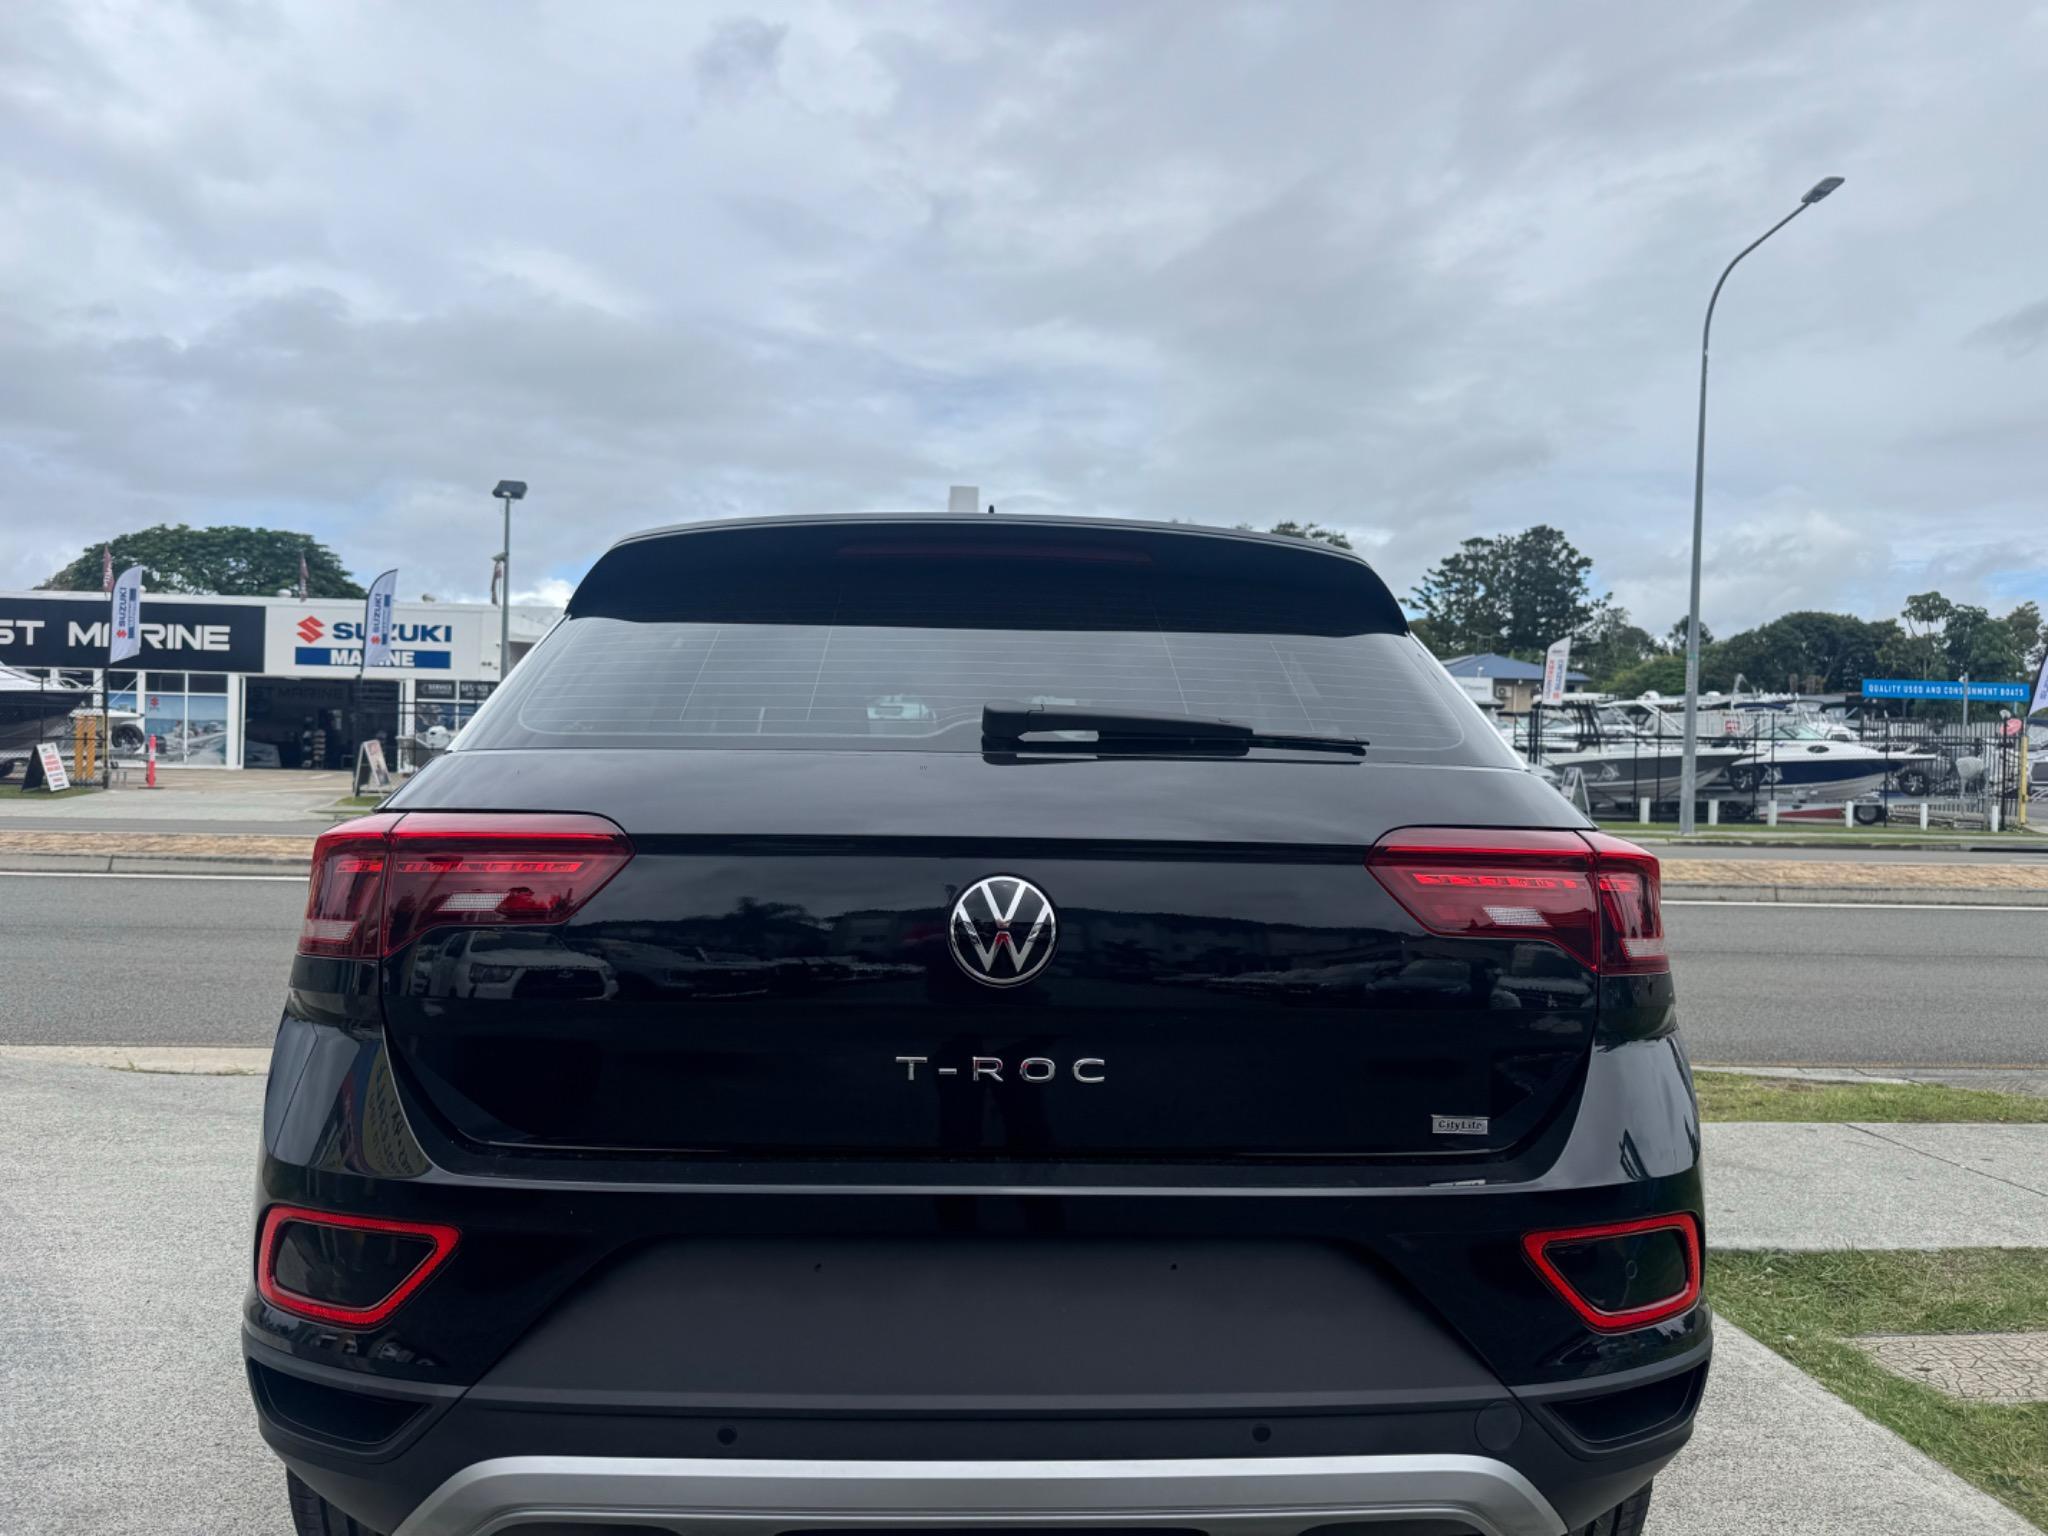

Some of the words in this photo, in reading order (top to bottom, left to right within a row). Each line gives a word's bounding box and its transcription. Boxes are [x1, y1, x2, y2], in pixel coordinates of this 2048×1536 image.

[68, 621, 231, 651] MRINE
[330, 649, 415, 667] MANE
[1868, 684, 1901, 693] QUALITY
[1903, 685, 1923, 694] USED
[1926, 686, 1942, 695] AND
[1943, 686, 1997, 696] CONSGNMENT
[2000, 687, 2024, 697] BOATS
[896, 1056, 1105, 1083] T-ROC
[1438, 1119, 1483, 1130] CityLife
